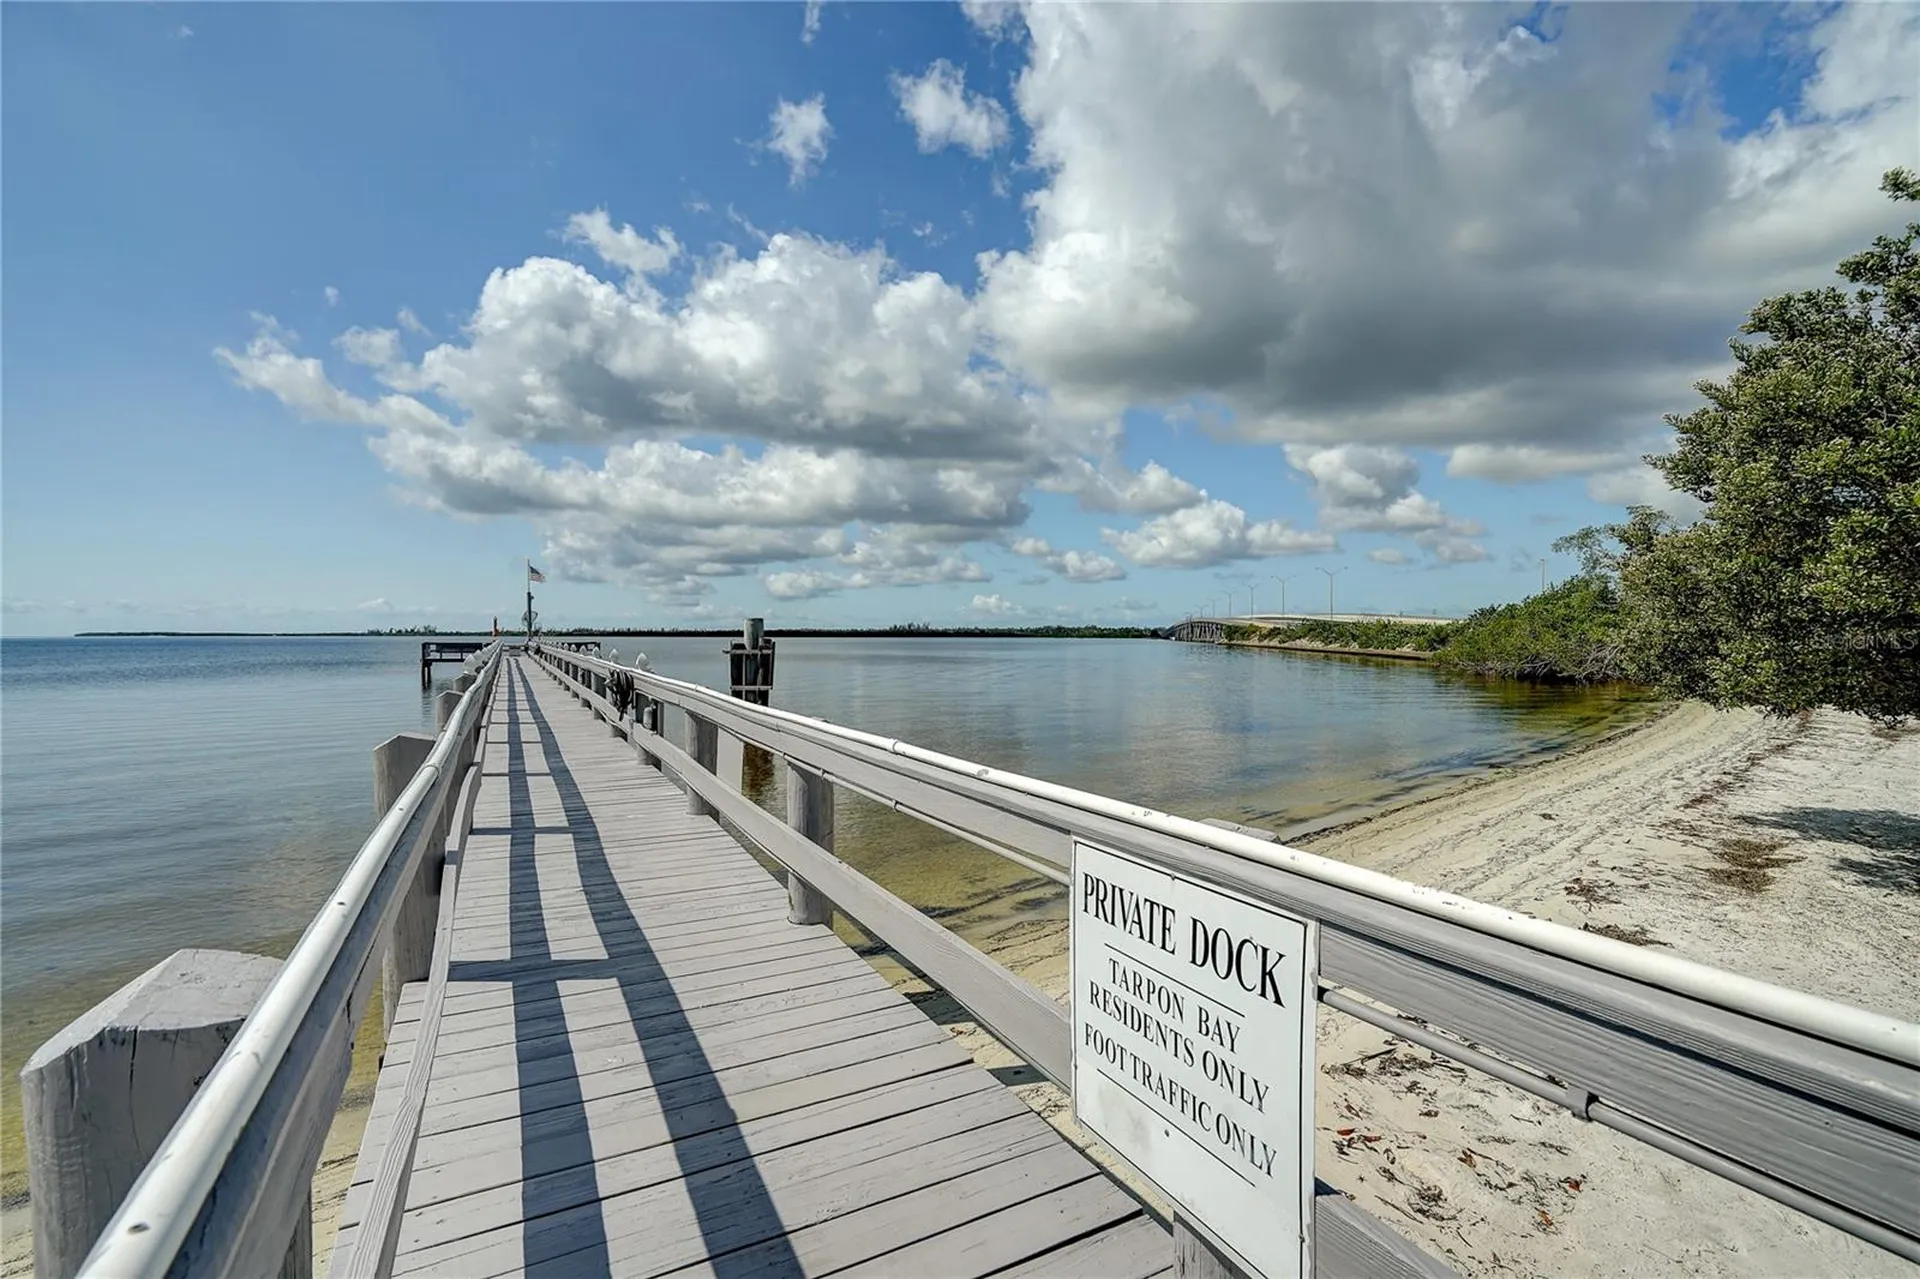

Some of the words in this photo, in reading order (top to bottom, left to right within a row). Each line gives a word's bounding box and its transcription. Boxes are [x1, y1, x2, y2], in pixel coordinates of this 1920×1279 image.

[1083, 872, 1176, 955] PRIVATE
[1189, 916, 1286, 1009] DOCK
[1109, 957, 1185, 1023] TARPON
[1197, 1004, 1240, 1054] BAY
[1085, 1022, 1127, 1072] FOOT
[1129, 1052, 1211, 1132] TRAFFIC
[1215, 1113, 1277, 1178] ONLY
[1089, 980, 1195, 1067] RESIDENTS
[1202, 1050, 1269, 1114] ONLY
